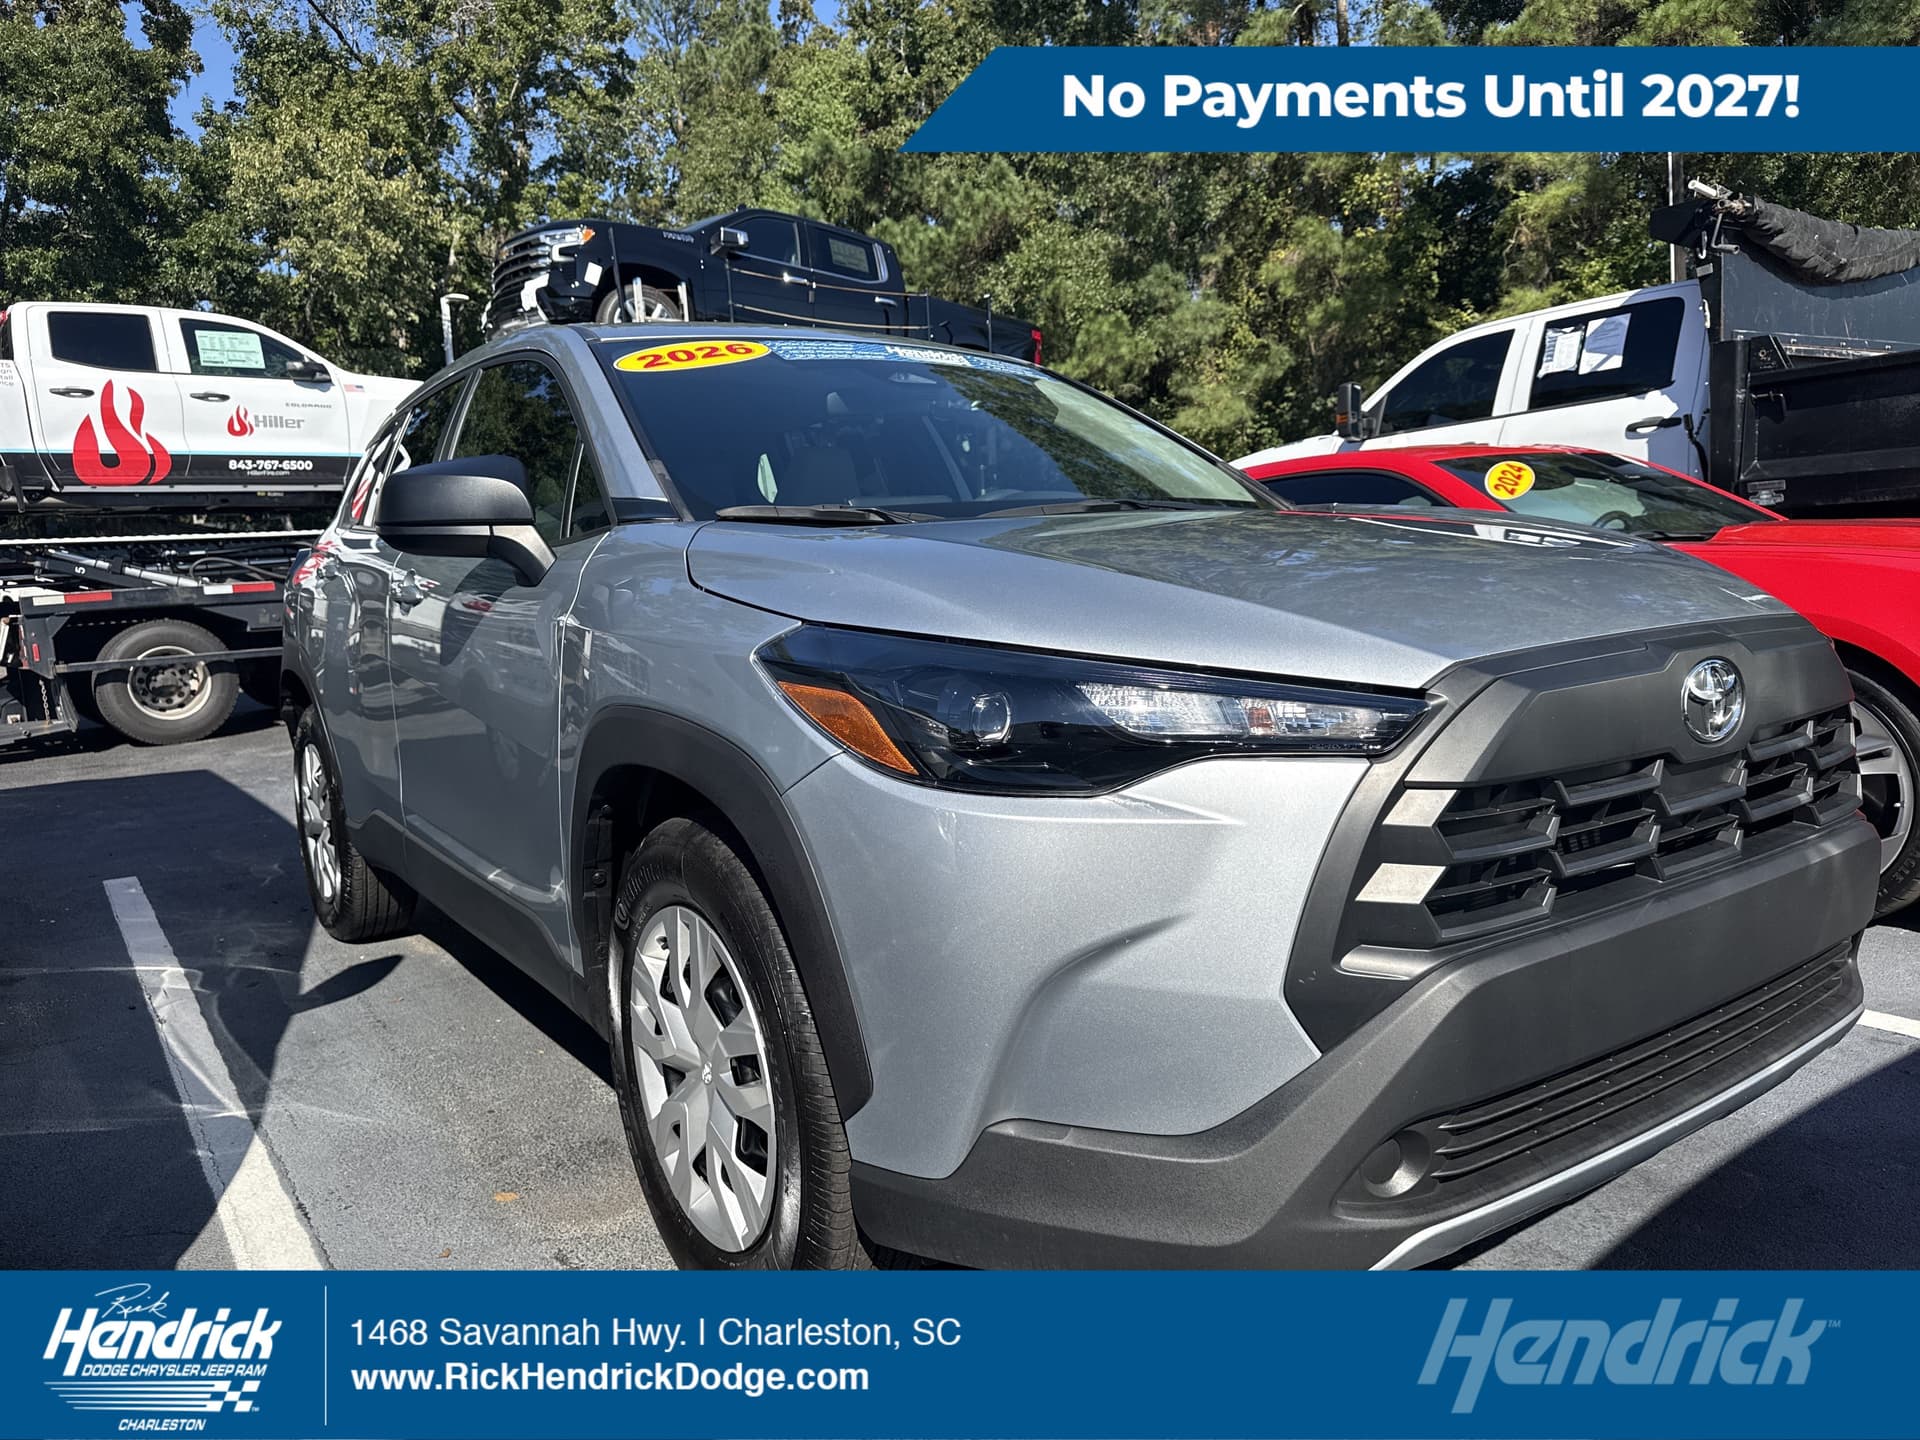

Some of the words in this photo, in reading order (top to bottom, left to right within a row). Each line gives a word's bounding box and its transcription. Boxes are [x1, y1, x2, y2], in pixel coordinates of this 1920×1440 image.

[637, 344, 753, 368] 2026
[254, 414, 305, 429] Hiller
[228, 459, 313, 470] 843-767-6500
[1494, 463, 1526, 495] 2024
